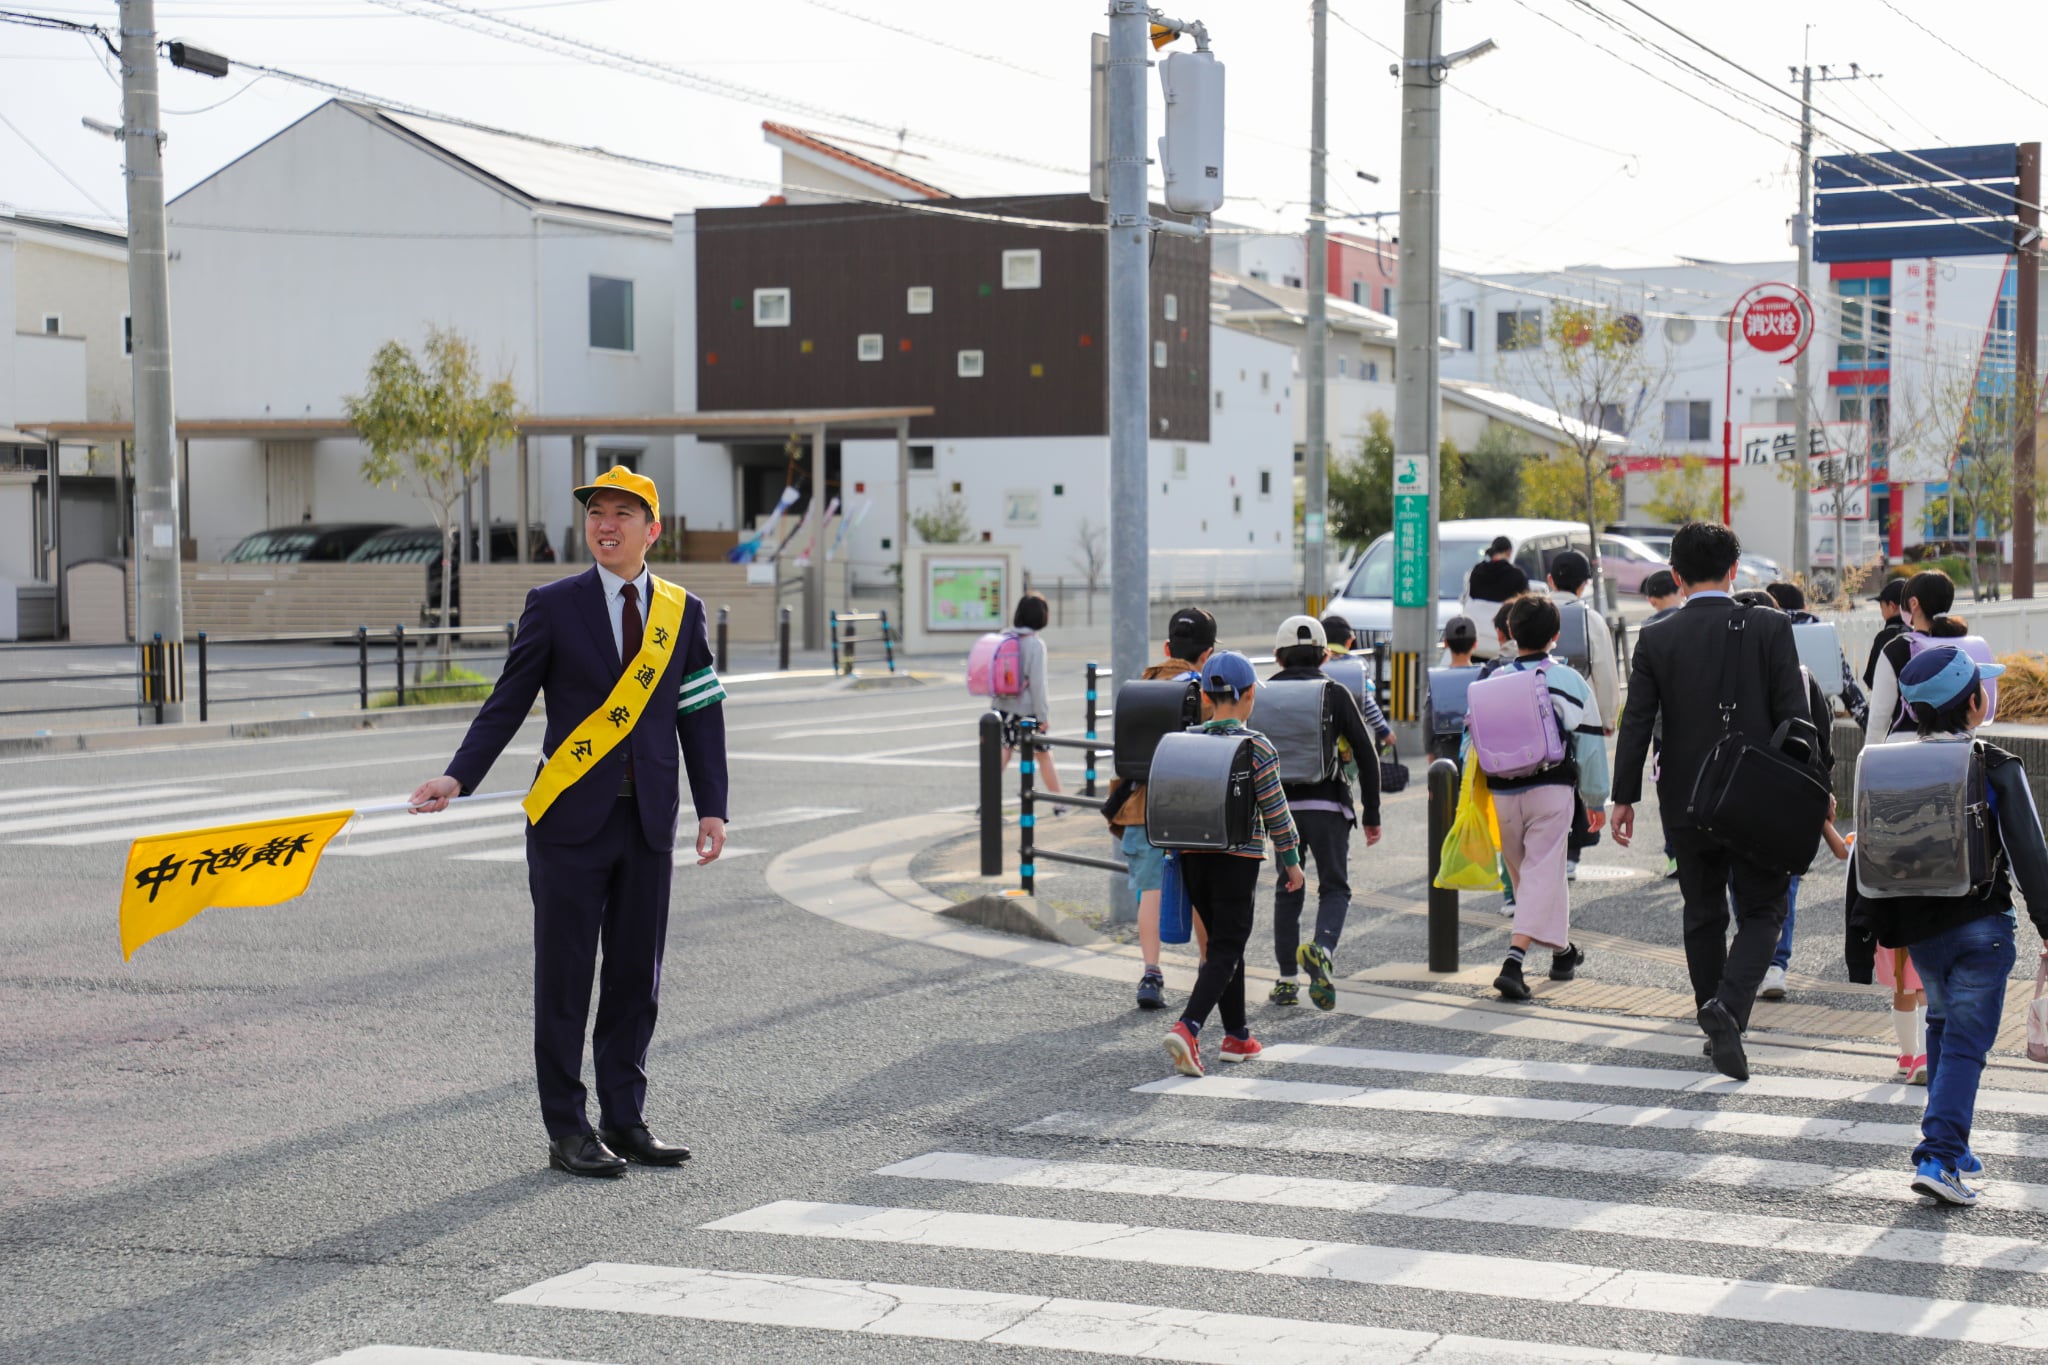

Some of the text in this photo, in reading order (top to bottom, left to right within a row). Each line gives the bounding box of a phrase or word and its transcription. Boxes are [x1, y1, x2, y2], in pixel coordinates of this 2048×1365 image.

[1747, 312, 1796, 336] 消火栓
[1402, 522, 1415, 603] 福間南小学校
[570, 626, 670, 762] 交通安全
